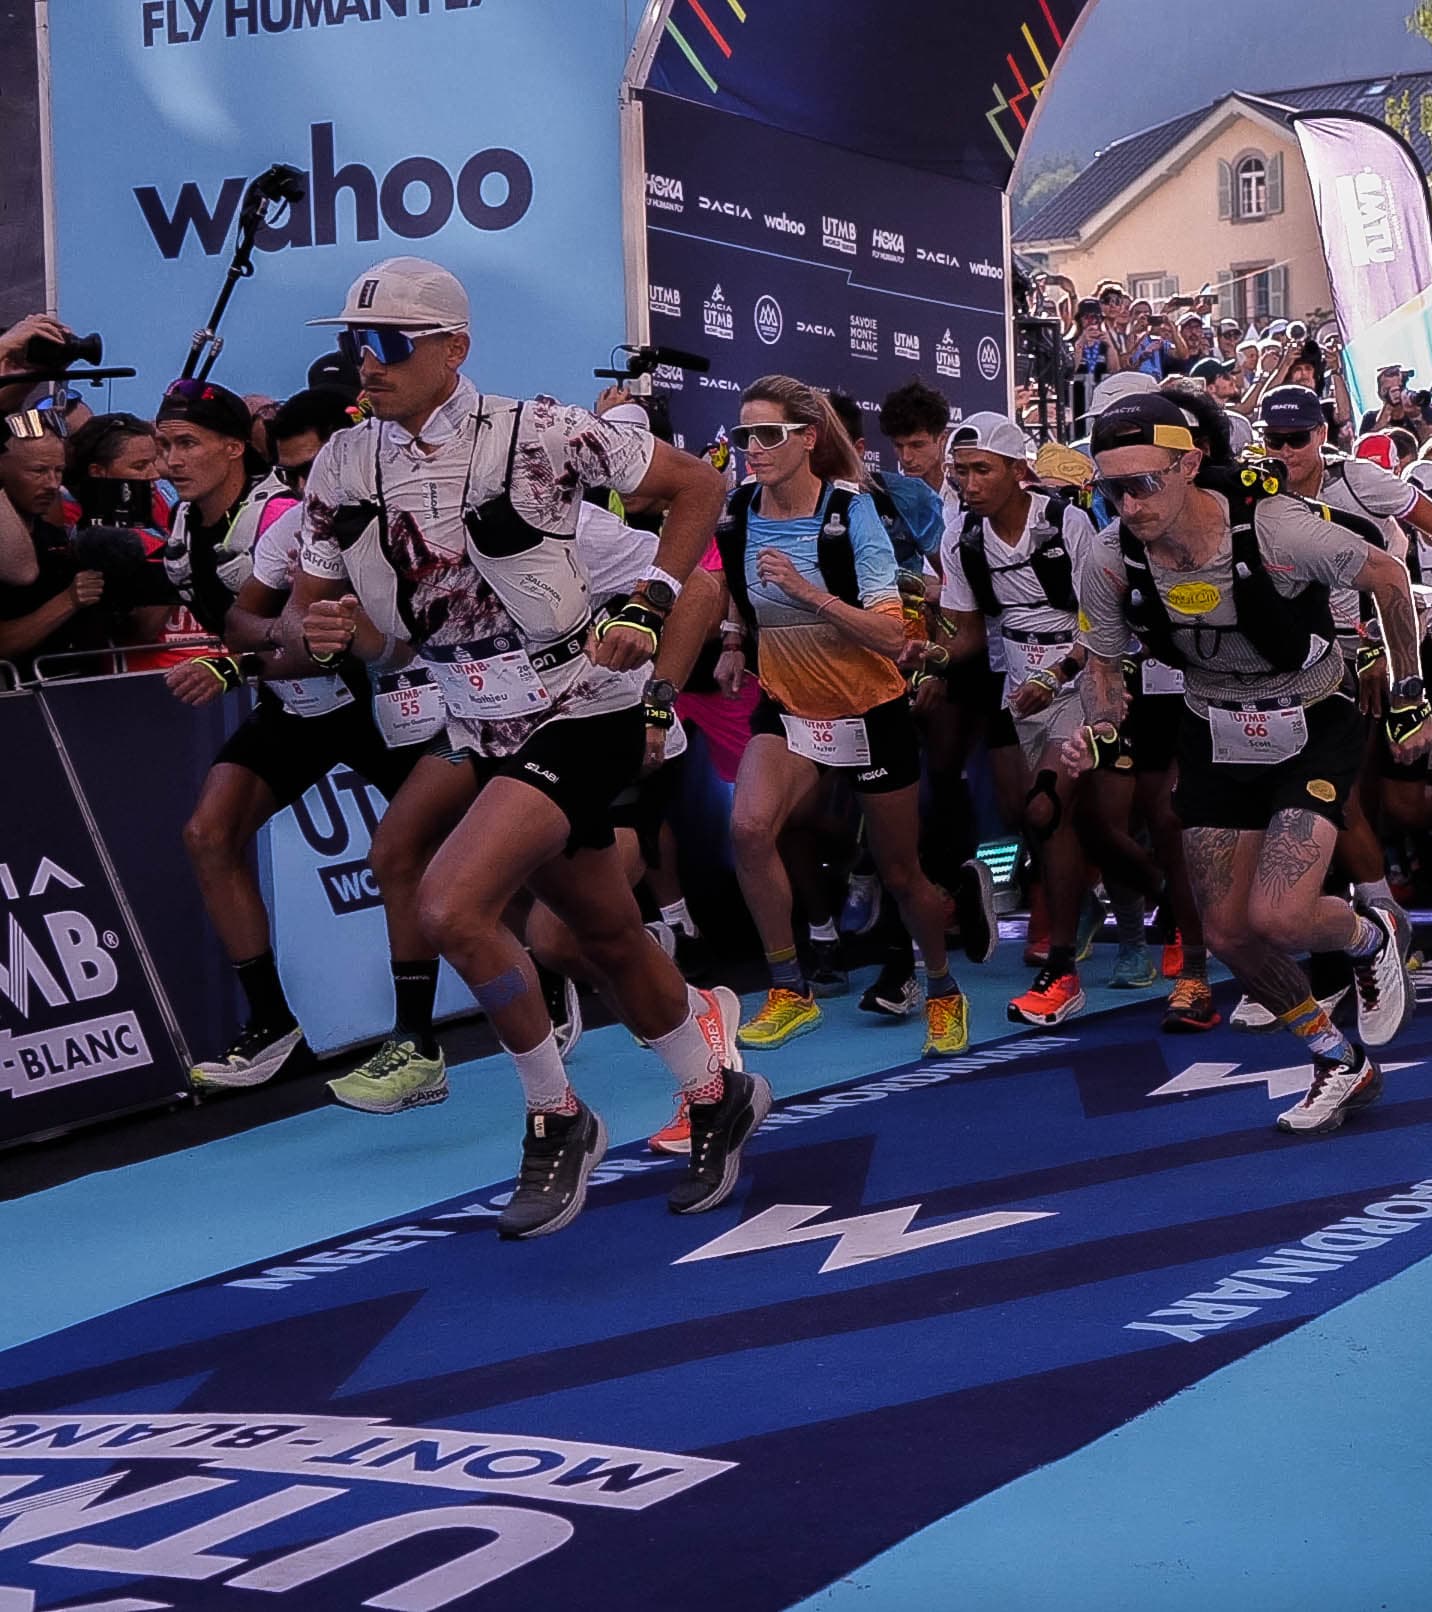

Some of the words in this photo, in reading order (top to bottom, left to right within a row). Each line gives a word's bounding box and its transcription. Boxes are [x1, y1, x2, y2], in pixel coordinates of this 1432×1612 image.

[142, 0, 213, 48] FLY
[134, 121, 534, 260] wahoo
[646, 172, 684, 201] HOKA
[699, 196, 753, 220] DACIA
[764, 212, 806, 236] wahoo
[822, 215, 857, 241] UTMB
[872, 228, 905, 253] HOKA
[916, 248, 961, 268] DACIA
[969, 259, 1004, 279] wahoo
[649, 284, 681, 306] UTMB
[703, 300, 733, 312] DACIA
[703, 308, 734, 329] UTMB
[849, 314, 878, 330] SAVOIE
[796, 321, 836, 338] DACIA
[850, 338, 878, 353] BLANC
[893, 331, 920, 350] UTMB
[935, 351, 961, 368] UTMB
[699, 376, 741, 392] DACIA
[1020, 644, 1049, 653] UTMB
[1027, 653, 1044, 665] 37
[450, 661, 490, 675] UTMB
[468, 675, 484, 691] 9
[390, 690, 422, 702] UTMB
[400, 701, 420, 716] 55
[1231, 711, 1271, 722] UTMB
[803, 719, 837, 730] UTMB
[1244, 724, 1269, 738] 66
[813, 730, 833, 743] 36
[857, 767, 889, 781] HOKA
[223, 1224, 459, 1291] MEET
